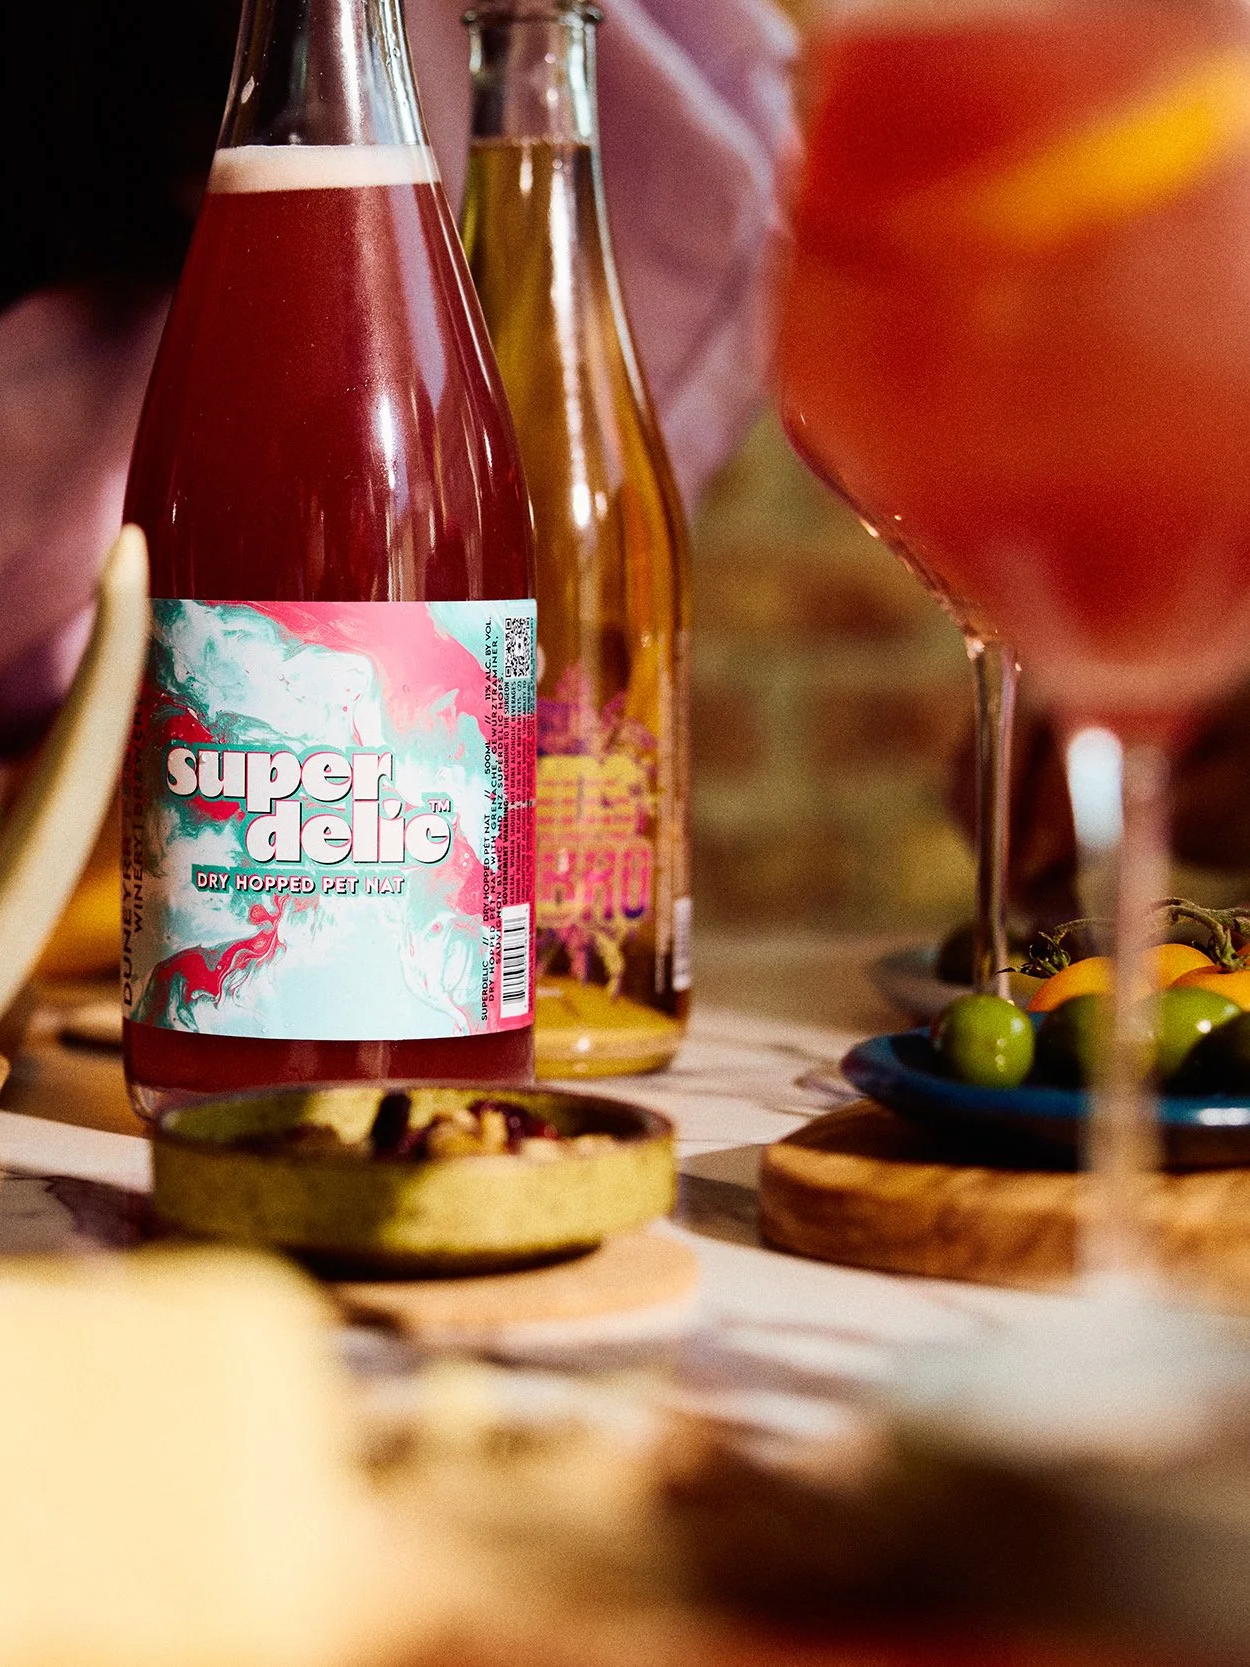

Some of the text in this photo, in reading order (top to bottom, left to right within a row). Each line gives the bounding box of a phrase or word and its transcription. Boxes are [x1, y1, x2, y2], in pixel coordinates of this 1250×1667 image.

[504, 731, 510, 740] TO
[166, 747, 393, 814] super
[497, 794, 503, 810] NZ
[246, 799, 450, 864] delic
[481, 961, 489, 1021] SUPERDELIC
[485, 644, 491, 656] BY
[133, 835, 143, 933] WINERY
[196, 871, 405, 895] DRY HOPPED PET NAT
